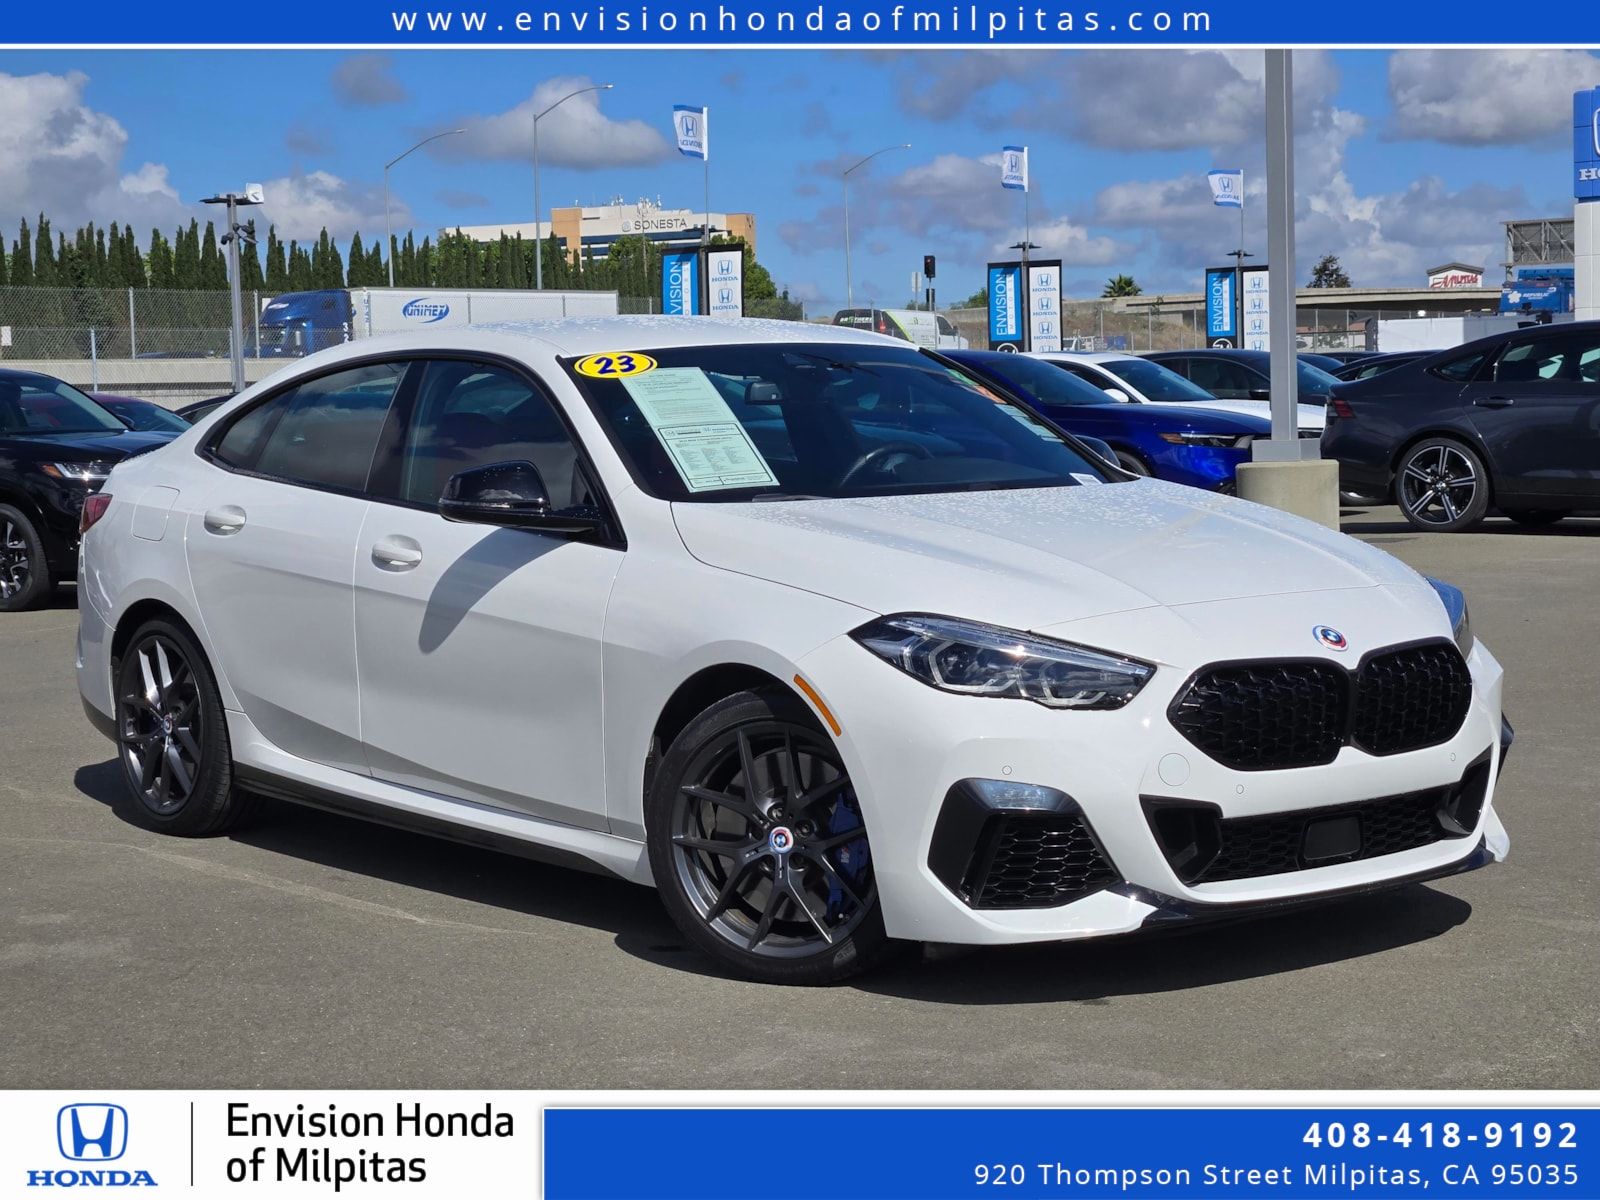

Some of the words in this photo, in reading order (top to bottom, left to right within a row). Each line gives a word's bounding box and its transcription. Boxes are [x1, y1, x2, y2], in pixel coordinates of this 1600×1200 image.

[634, 218, 687, 230] SONESTA
[406, 304, 446, 317] UNIMEX
[995, 274, 1007, 336] ENVISION
[1212, 278, 1223, 332] ENVISION
[594, 355, 636, 374] 23
